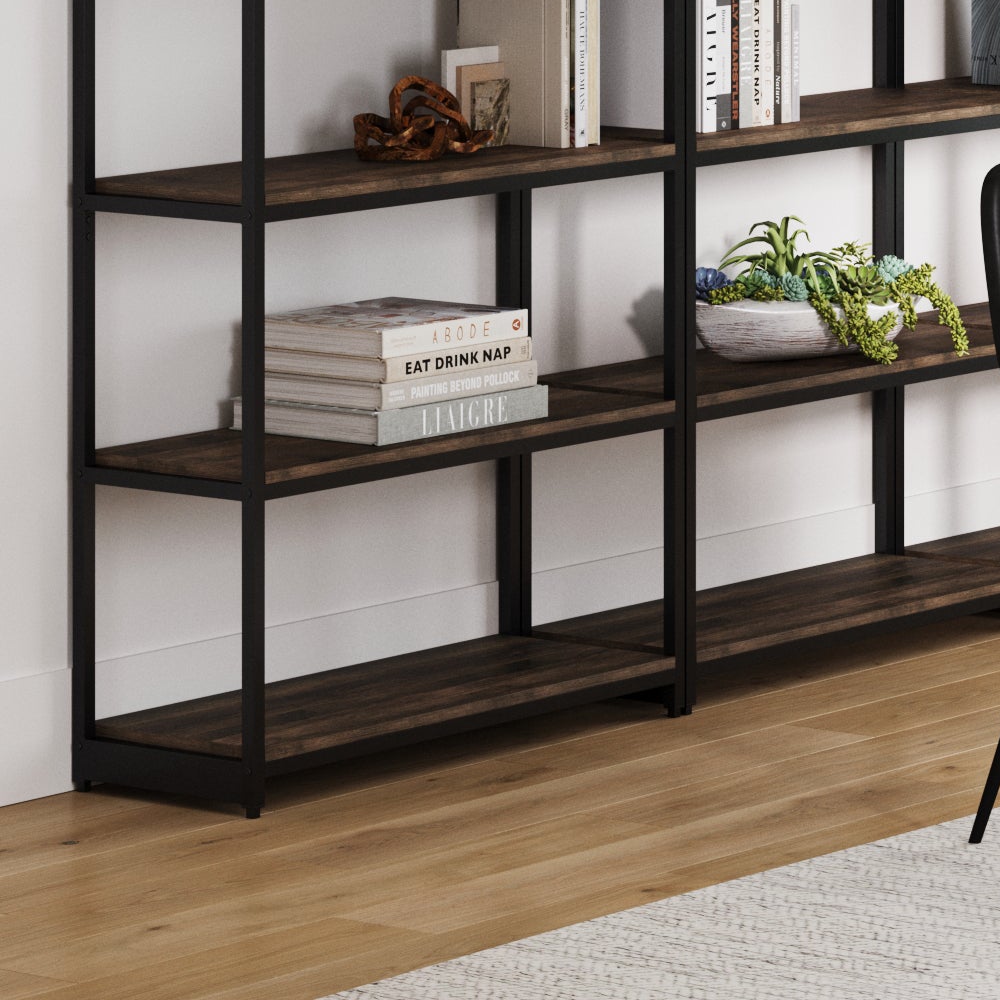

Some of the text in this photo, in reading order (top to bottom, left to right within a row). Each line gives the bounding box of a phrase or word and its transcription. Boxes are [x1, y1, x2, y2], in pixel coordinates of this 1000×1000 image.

[731, 26, 739, 121] WEARSTLER
[432, 320, 491, 345] ABODE
[405, 359, 431, 375] EAT
[435, 350, 479, 370] DRINK
[482, 345, 512, 363] NAP
[410, 381, 449, 400] PAINTING
[450, 375, 483, 394] BEYOND
[483, 370, 521, 388] POLLOCK
[421, 395, 509, 436] LIAIGRE
